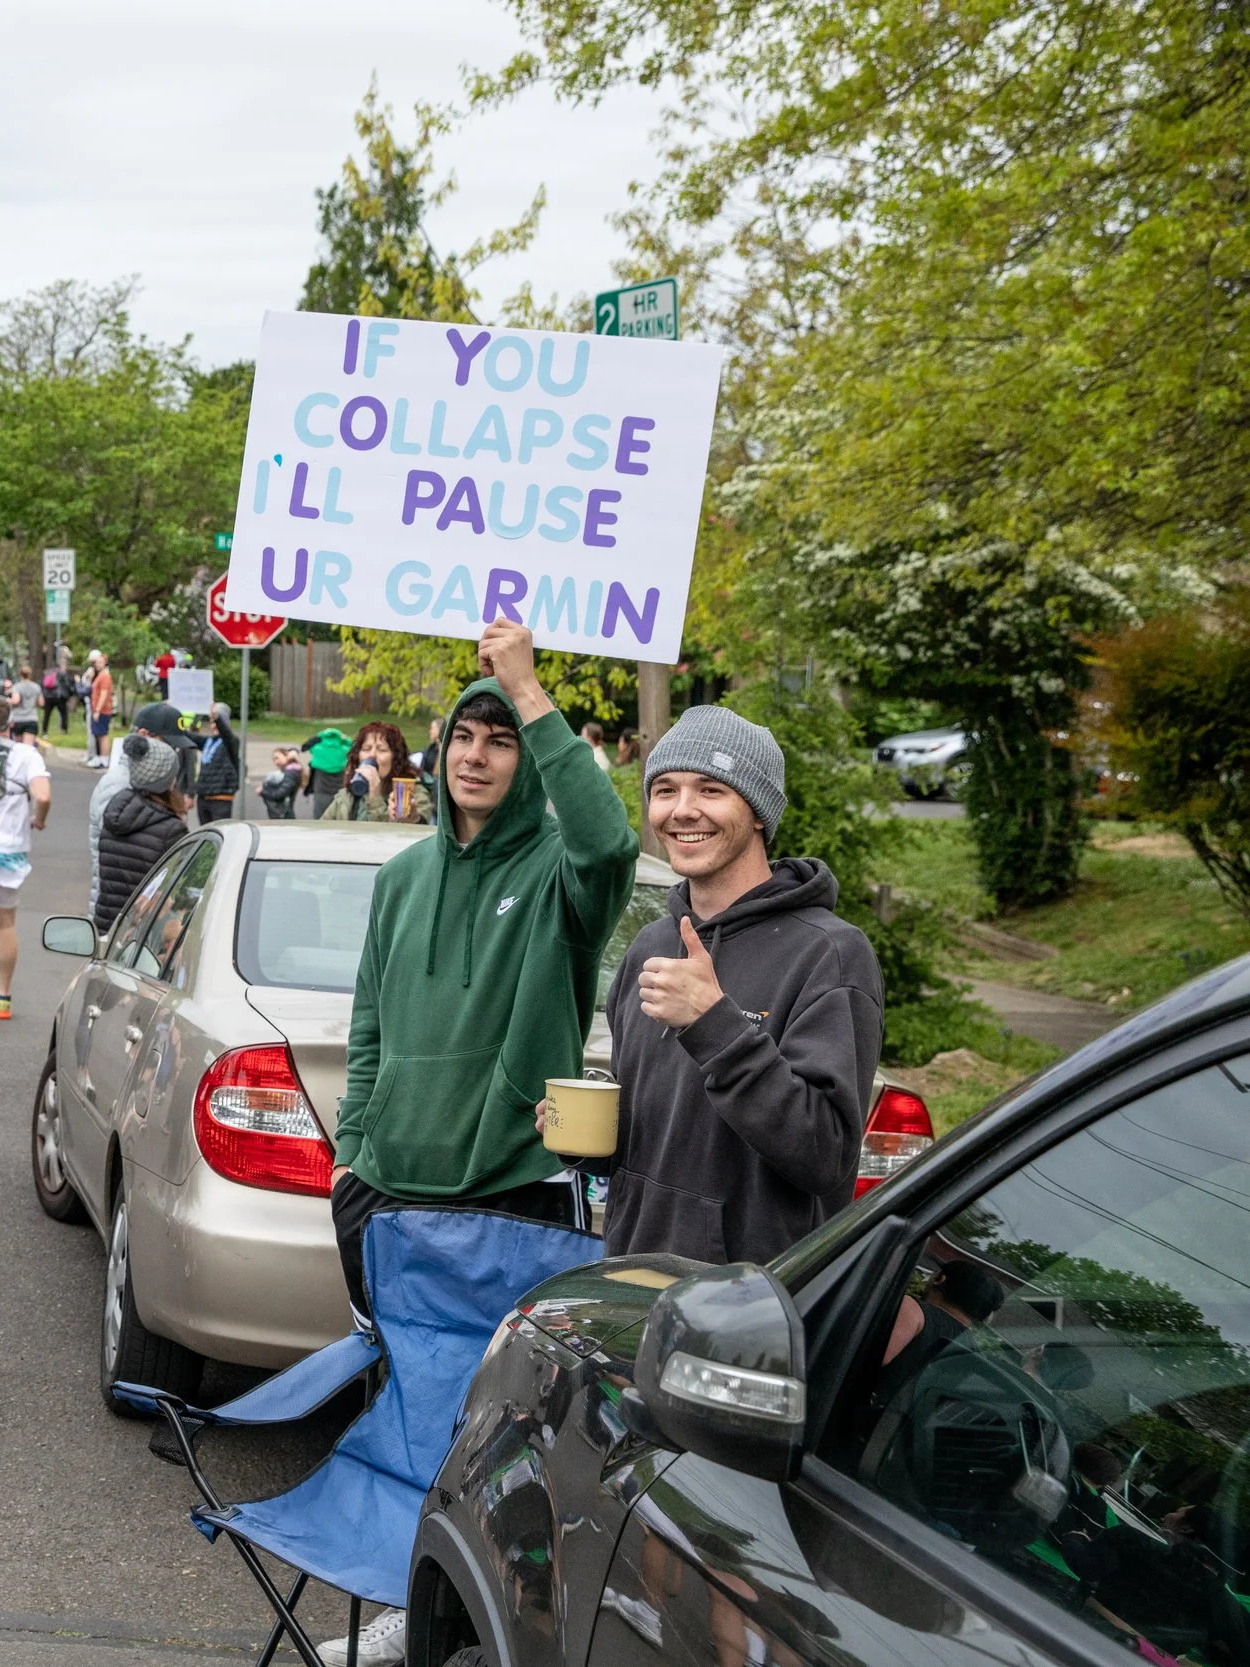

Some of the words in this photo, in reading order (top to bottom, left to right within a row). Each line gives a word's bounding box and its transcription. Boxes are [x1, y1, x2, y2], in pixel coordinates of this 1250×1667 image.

[598, 302, 616, 335] 2
[622, 314, 673, 338] PARKING
[633, 291, 658, 314] HR
[343, 320, 399, 378] IF
[446, 328, 591, 397] YOU
[294, 392, 656, 476] COLLAPSE
[253, 452, 354, 524] I'LL
[401, 468, 623, 548] PAUSE
[47, 570, 72, 585] 20
[260, 545, 353, 608] UR
[385, 559, 661, 645] GARMIN
